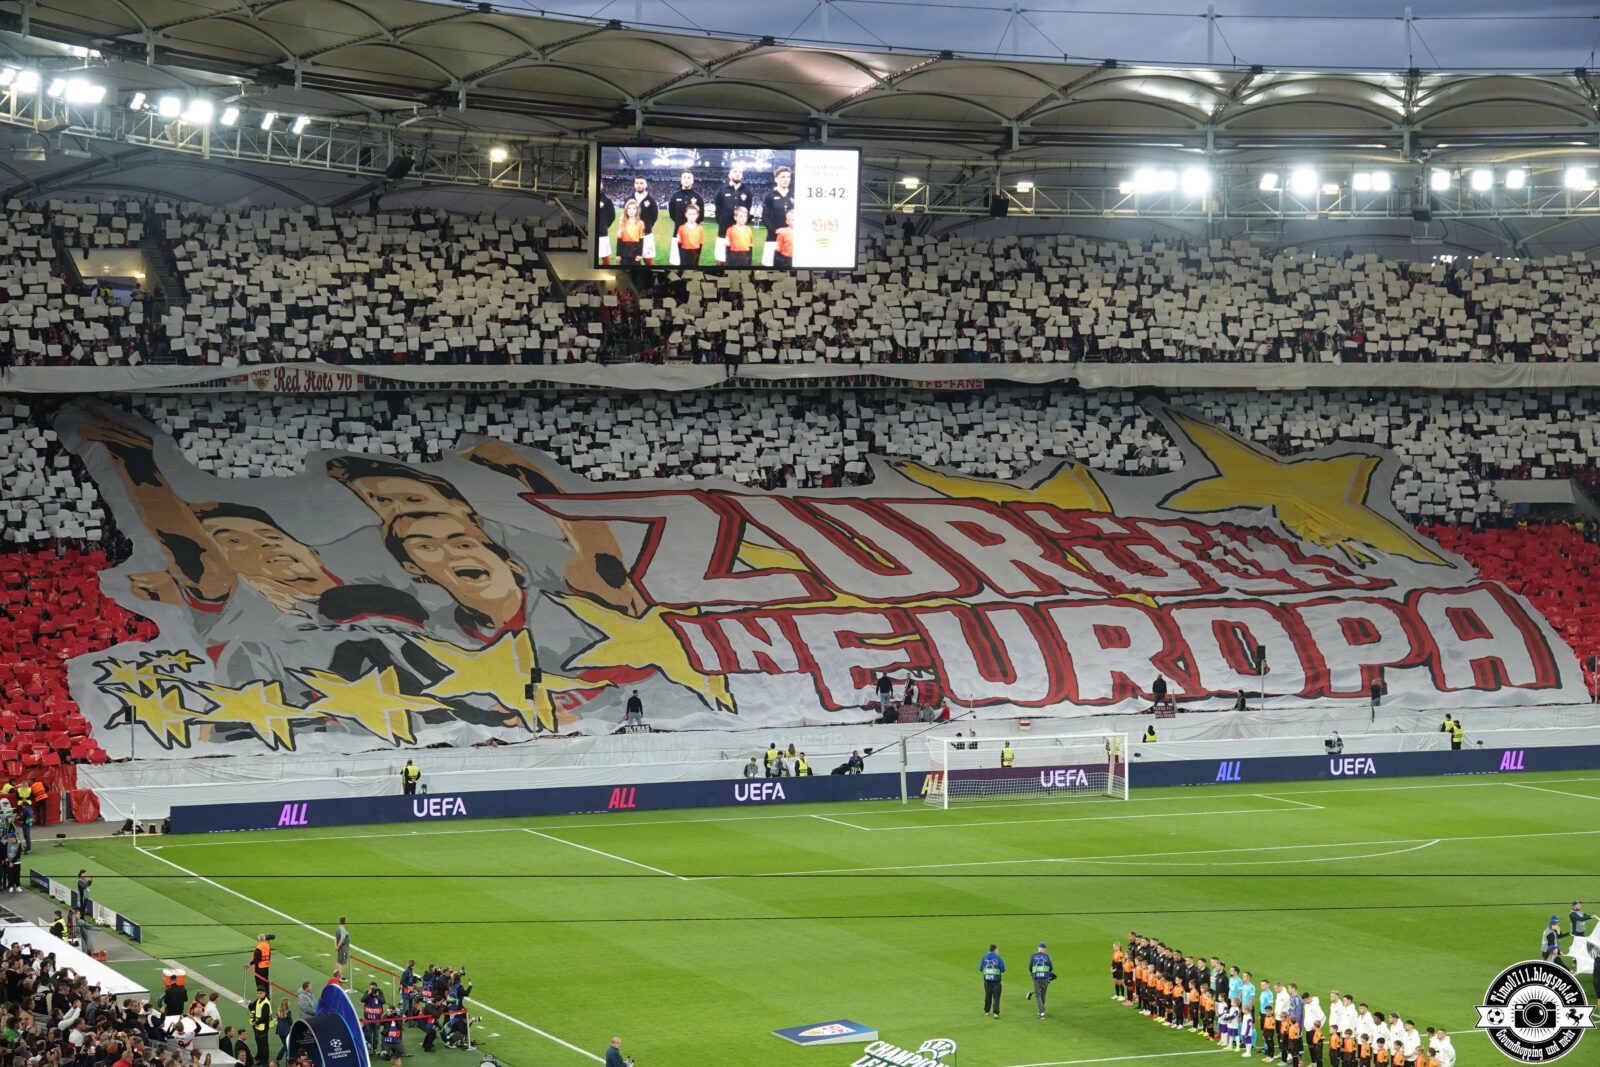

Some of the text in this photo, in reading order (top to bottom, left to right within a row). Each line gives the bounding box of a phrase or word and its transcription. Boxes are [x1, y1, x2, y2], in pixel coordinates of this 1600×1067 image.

[806, 187, 846, 199] 18:42
[274, 366, 300, 392] Red
[304, 370, 333, 392] Hots
[661, 581, 1562, 710] IN EUROPA
[1330, 757, 1376, 776] UEFA
[1500, 750, 1524, 770] ALL
[1040, 769, 1088, 788] UEFA
[1216, 761, 1242, 782] ALL
[608, 787, 636, 809] ALL
[734, 782, 785, 801] UEFA
[278, 803, 308, 826] ALL
[413, 797, 467, 818] UEFA
